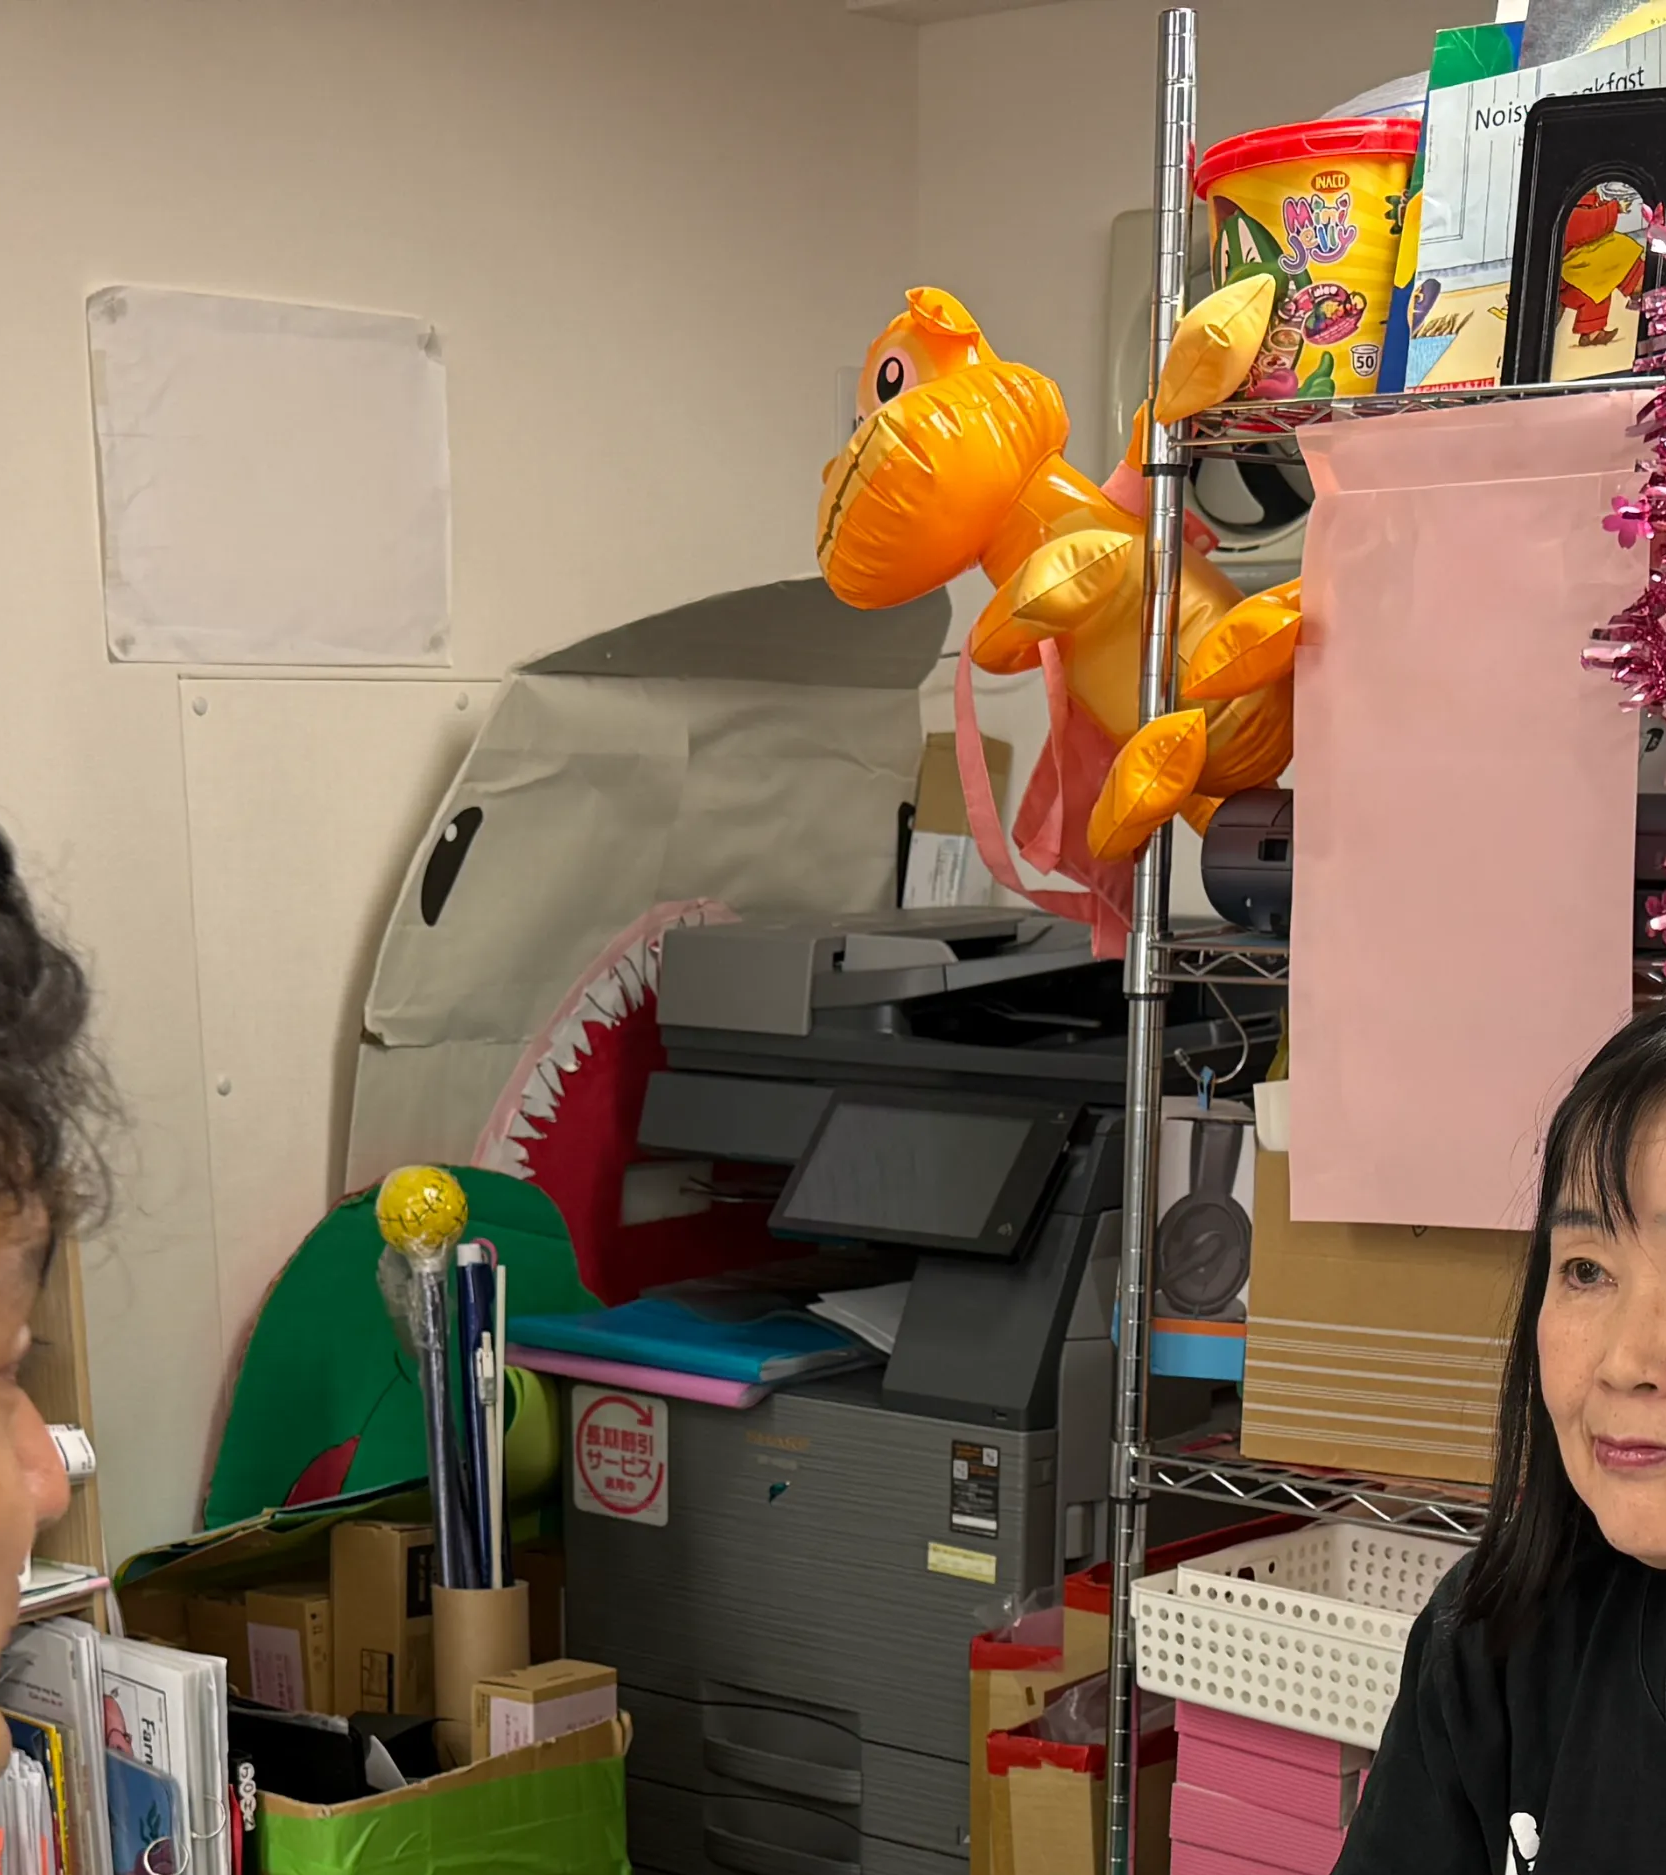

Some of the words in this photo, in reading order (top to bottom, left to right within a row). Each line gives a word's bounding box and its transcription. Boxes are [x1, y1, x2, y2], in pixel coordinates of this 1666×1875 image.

[1474, 101, 1533, 132] Noisy
[1315, 177, 1347, 189] INACO
[1283, 193, 1351, 234] Mini
[1279, 224, 1356, 274] Jelly
[1356, 356, 1374, 369] 50
[586, 1424, 653, 1457] 長期割引
[586, 1448, 653, 1480] サービス
[240, 1763, 256, 1830] JOHN
